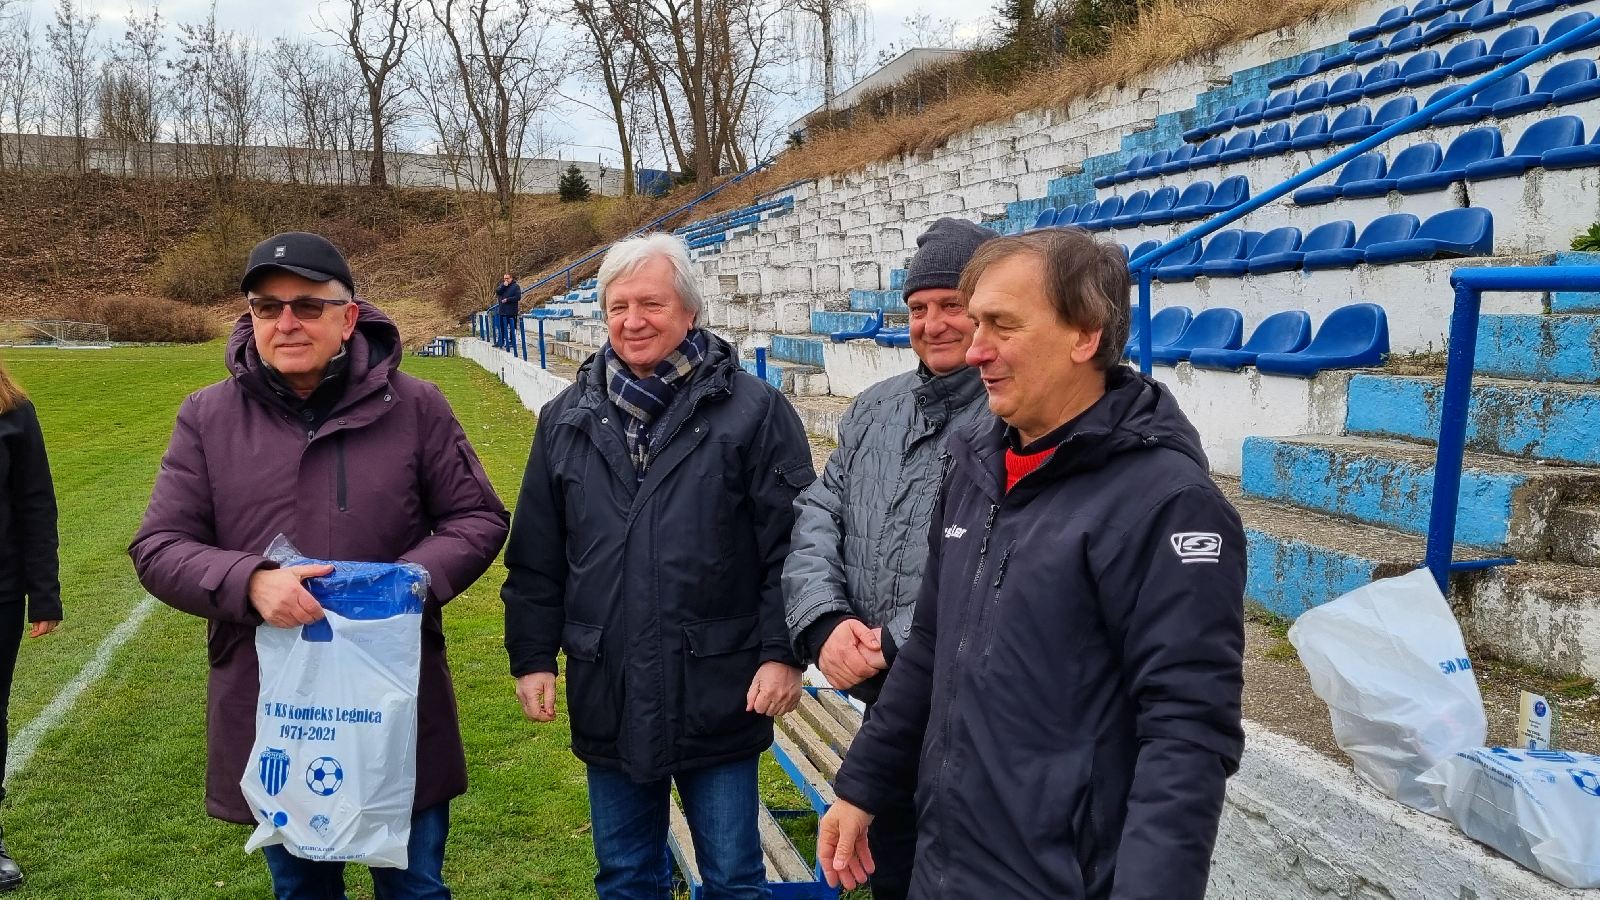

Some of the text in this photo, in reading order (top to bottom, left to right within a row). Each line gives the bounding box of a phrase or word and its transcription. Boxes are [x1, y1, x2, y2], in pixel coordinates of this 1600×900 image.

[1438, 657, 1472, 675] 50 la
[274, 702, 288, 718] KS
[335, 707, 383, 724] Legnica
[279, 724, 336, 741] 1971-2021
